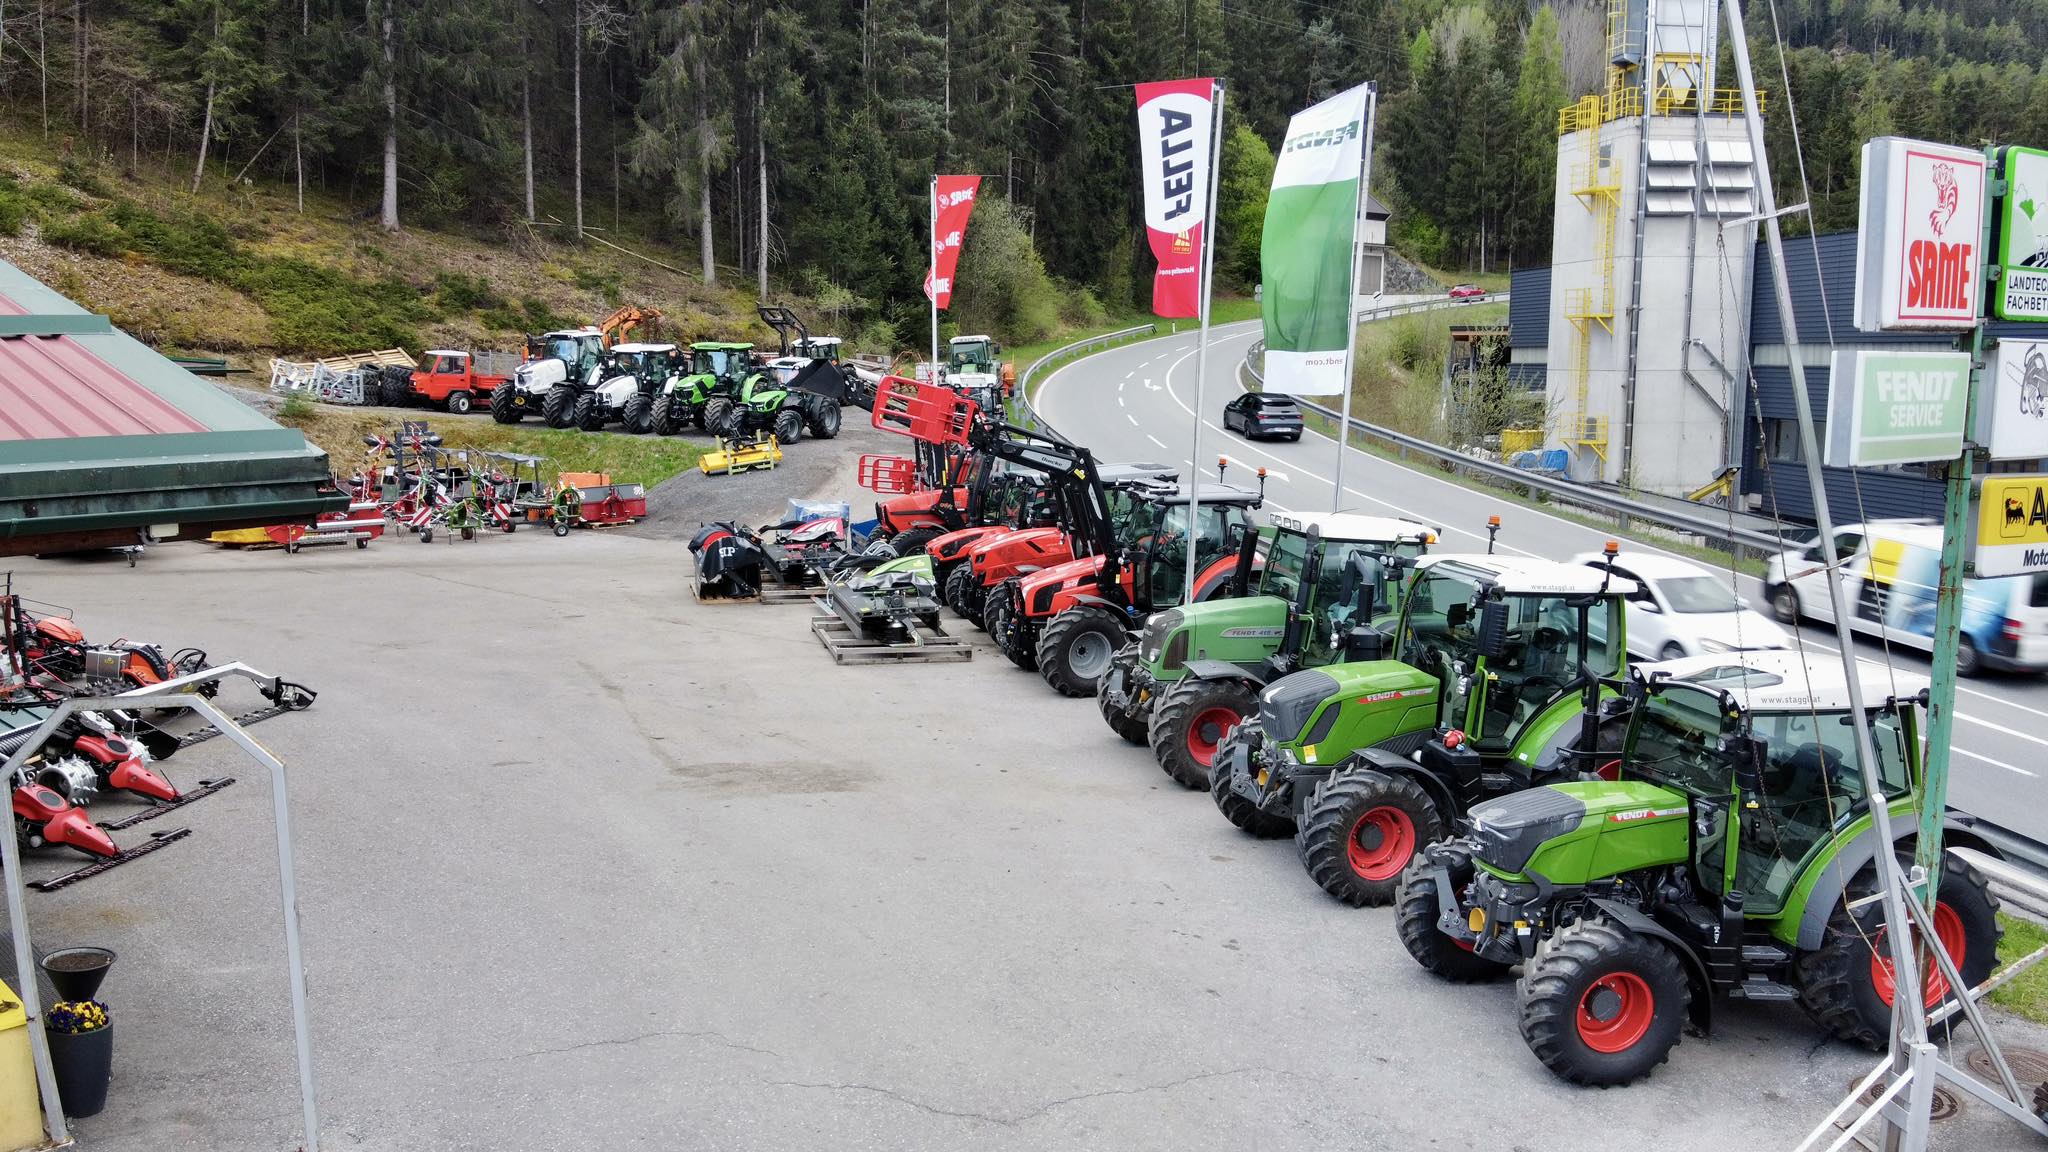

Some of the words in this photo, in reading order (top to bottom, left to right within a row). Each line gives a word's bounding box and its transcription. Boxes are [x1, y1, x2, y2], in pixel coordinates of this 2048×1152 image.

[1907, 239, 1972, 309] SAME
[2009, 275, 2048, 291] LANDTEC
[2007, 295, 2048, 310] FACHBET
[1876, 371, 1959, 402] FENDT
[1889, 403, 1944, 428] SERVICE
[2028, 486, 2048, 535] A
[1366, 690, 1398, 702] FENDT
[1761, 696, 1821, 705] www.stagglat
[1616, 810, 1650, 822] FENDT
